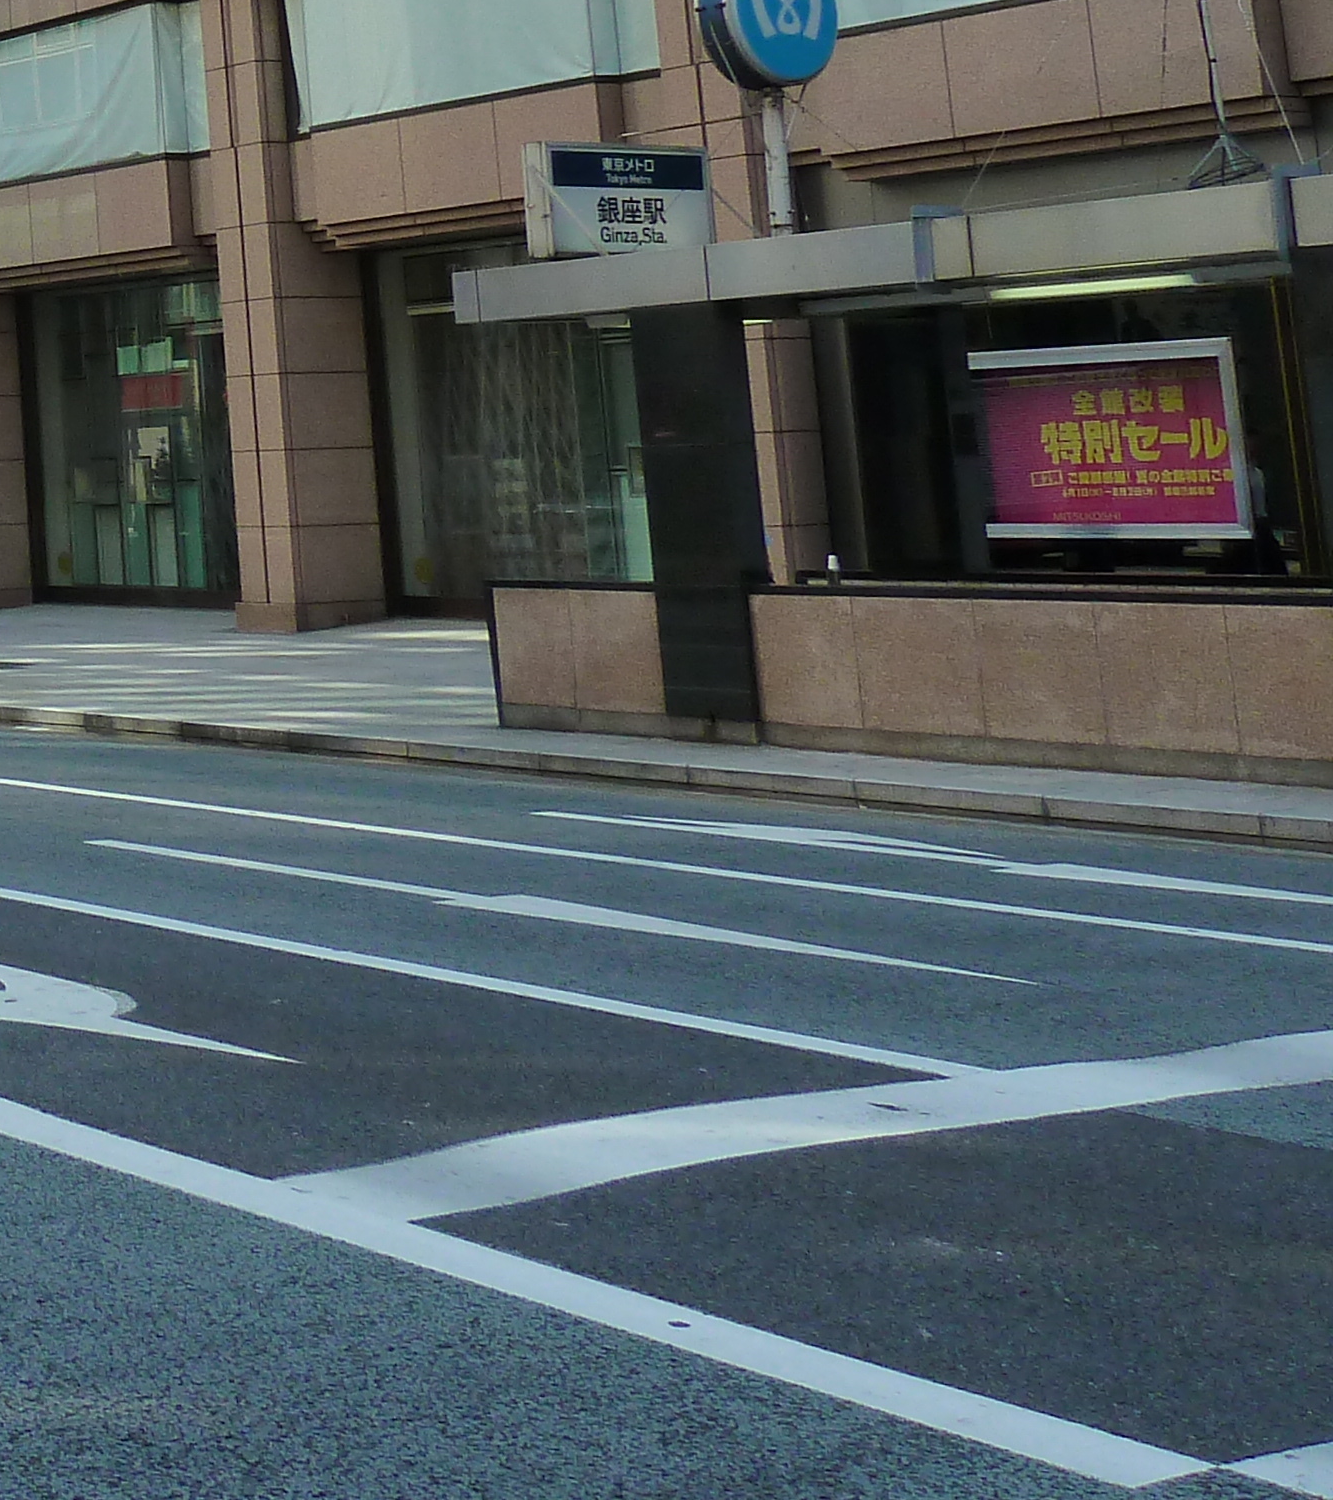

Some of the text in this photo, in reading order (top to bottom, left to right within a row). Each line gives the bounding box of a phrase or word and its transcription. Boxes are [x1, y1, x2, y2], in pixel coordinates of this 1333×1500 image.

[601, 156, 655, 173] 東京メトロ
[597, 196, 667, 225] 銀座駅
[600, 227, 640, 243] Ginza
[1039, 417, 1229, 466] 特別セール
